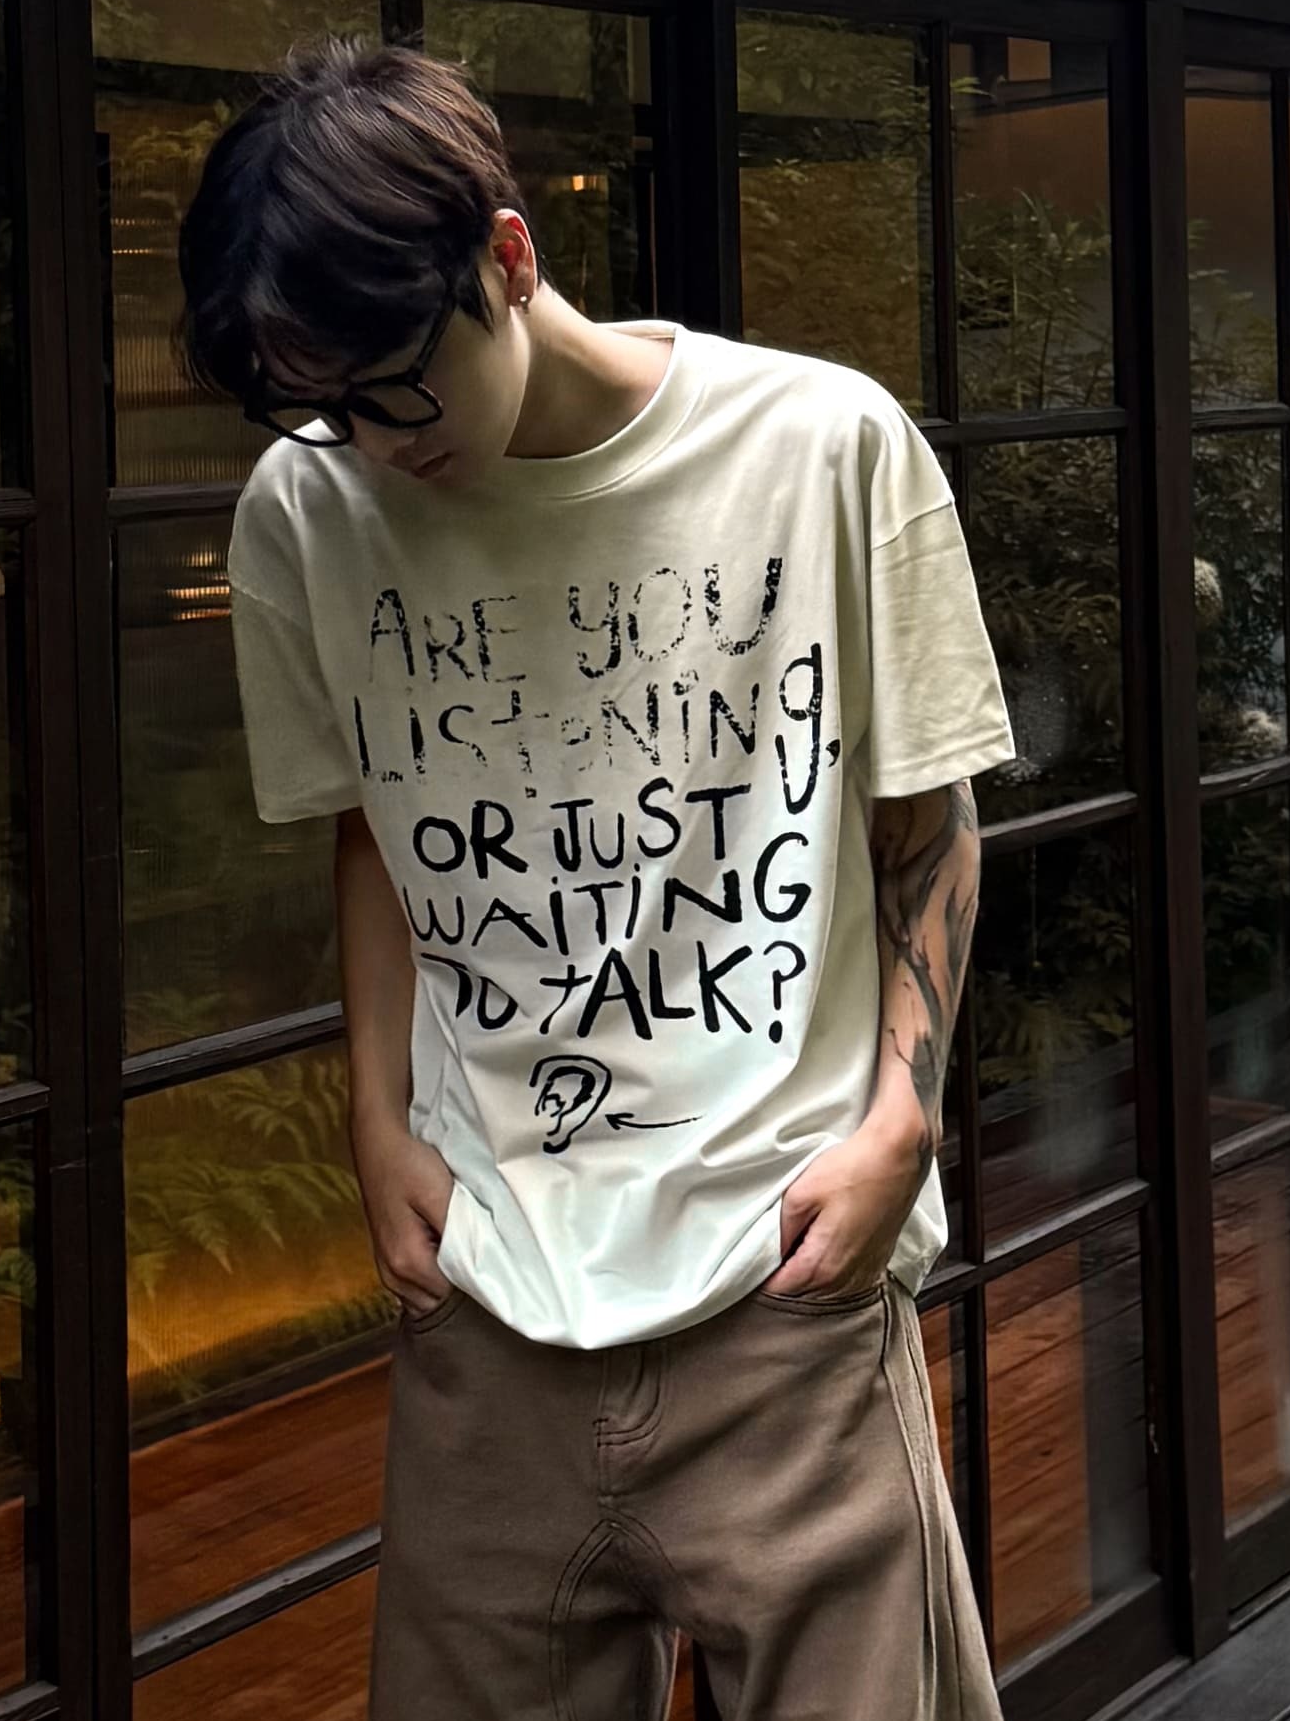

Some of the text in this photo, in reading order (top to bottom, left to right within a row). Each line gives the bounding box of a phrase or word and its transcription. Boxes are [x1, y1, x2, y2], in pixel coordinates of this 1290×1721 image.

[369, 588, 527, 683] ARE
[412, 776, 752, 880] OR JUST
